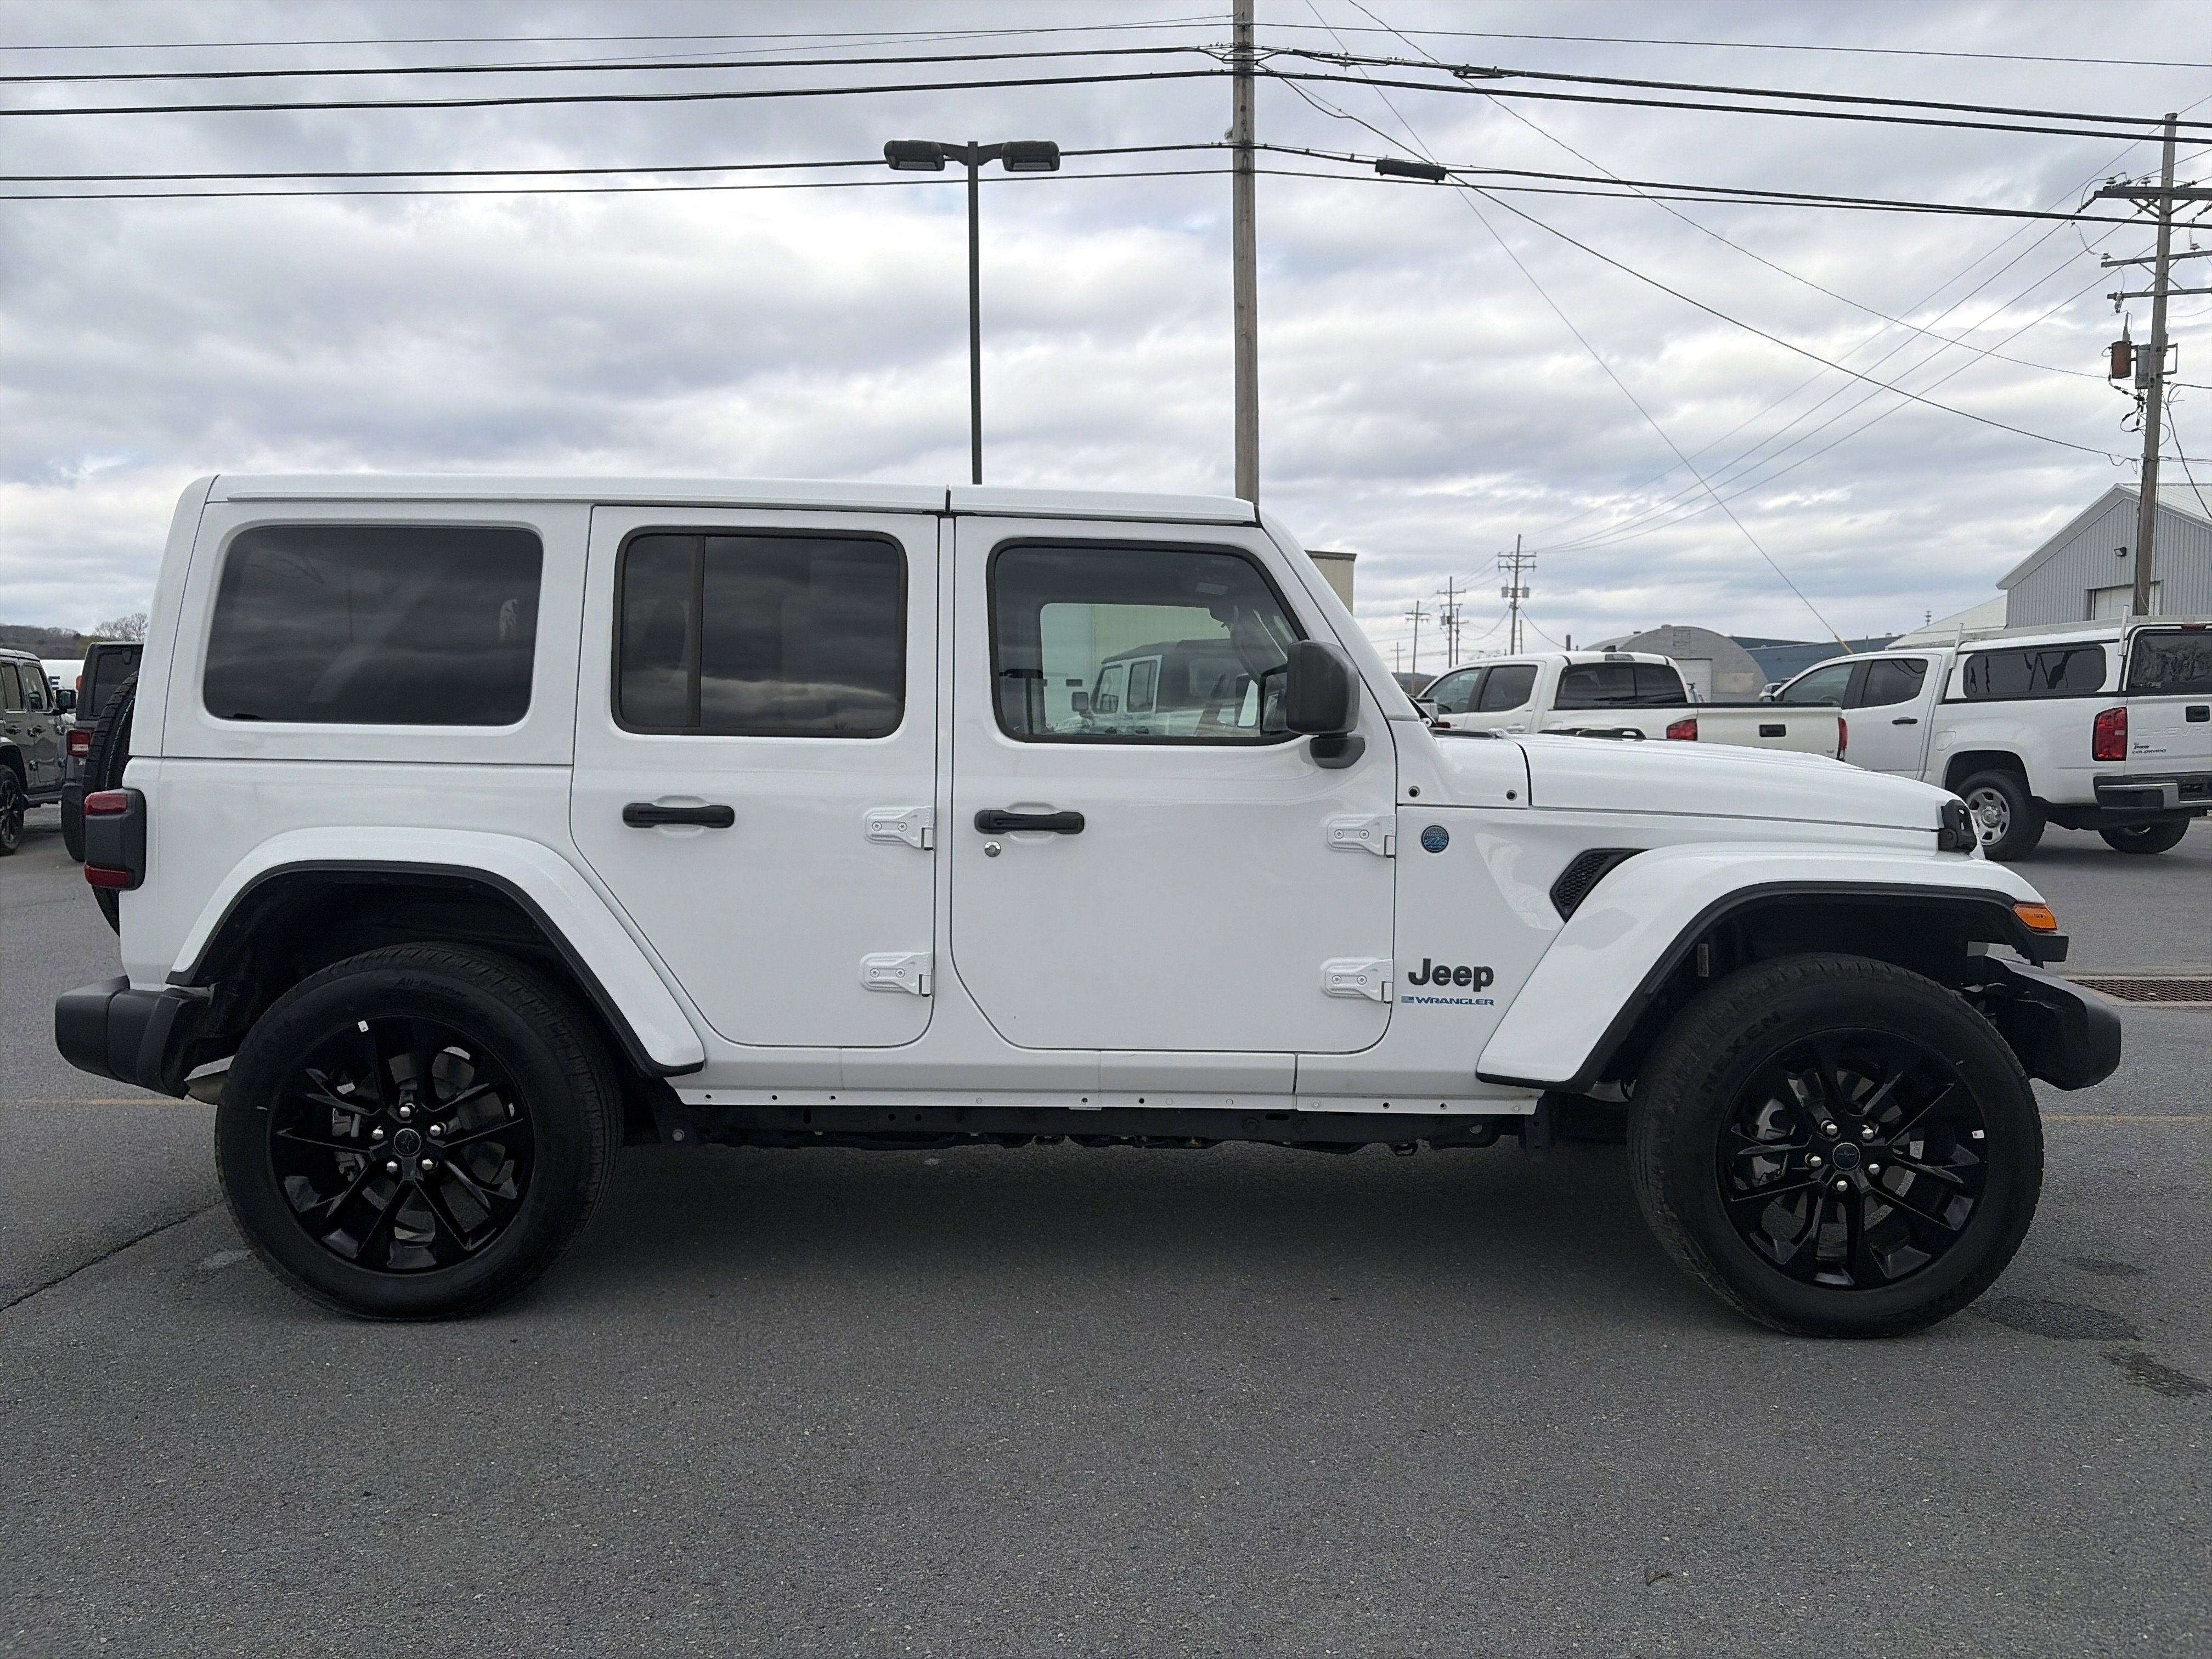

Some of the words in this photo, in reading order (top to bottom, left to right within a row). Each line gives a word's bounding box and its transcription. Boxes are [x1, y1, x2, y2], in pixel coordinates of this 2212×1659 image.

[1408, 958, 1494, 992] Jeep
[1415, 996, 1494, 1006] WRANGLER
[1701, 1011, 1781, 1092] NEXEN
